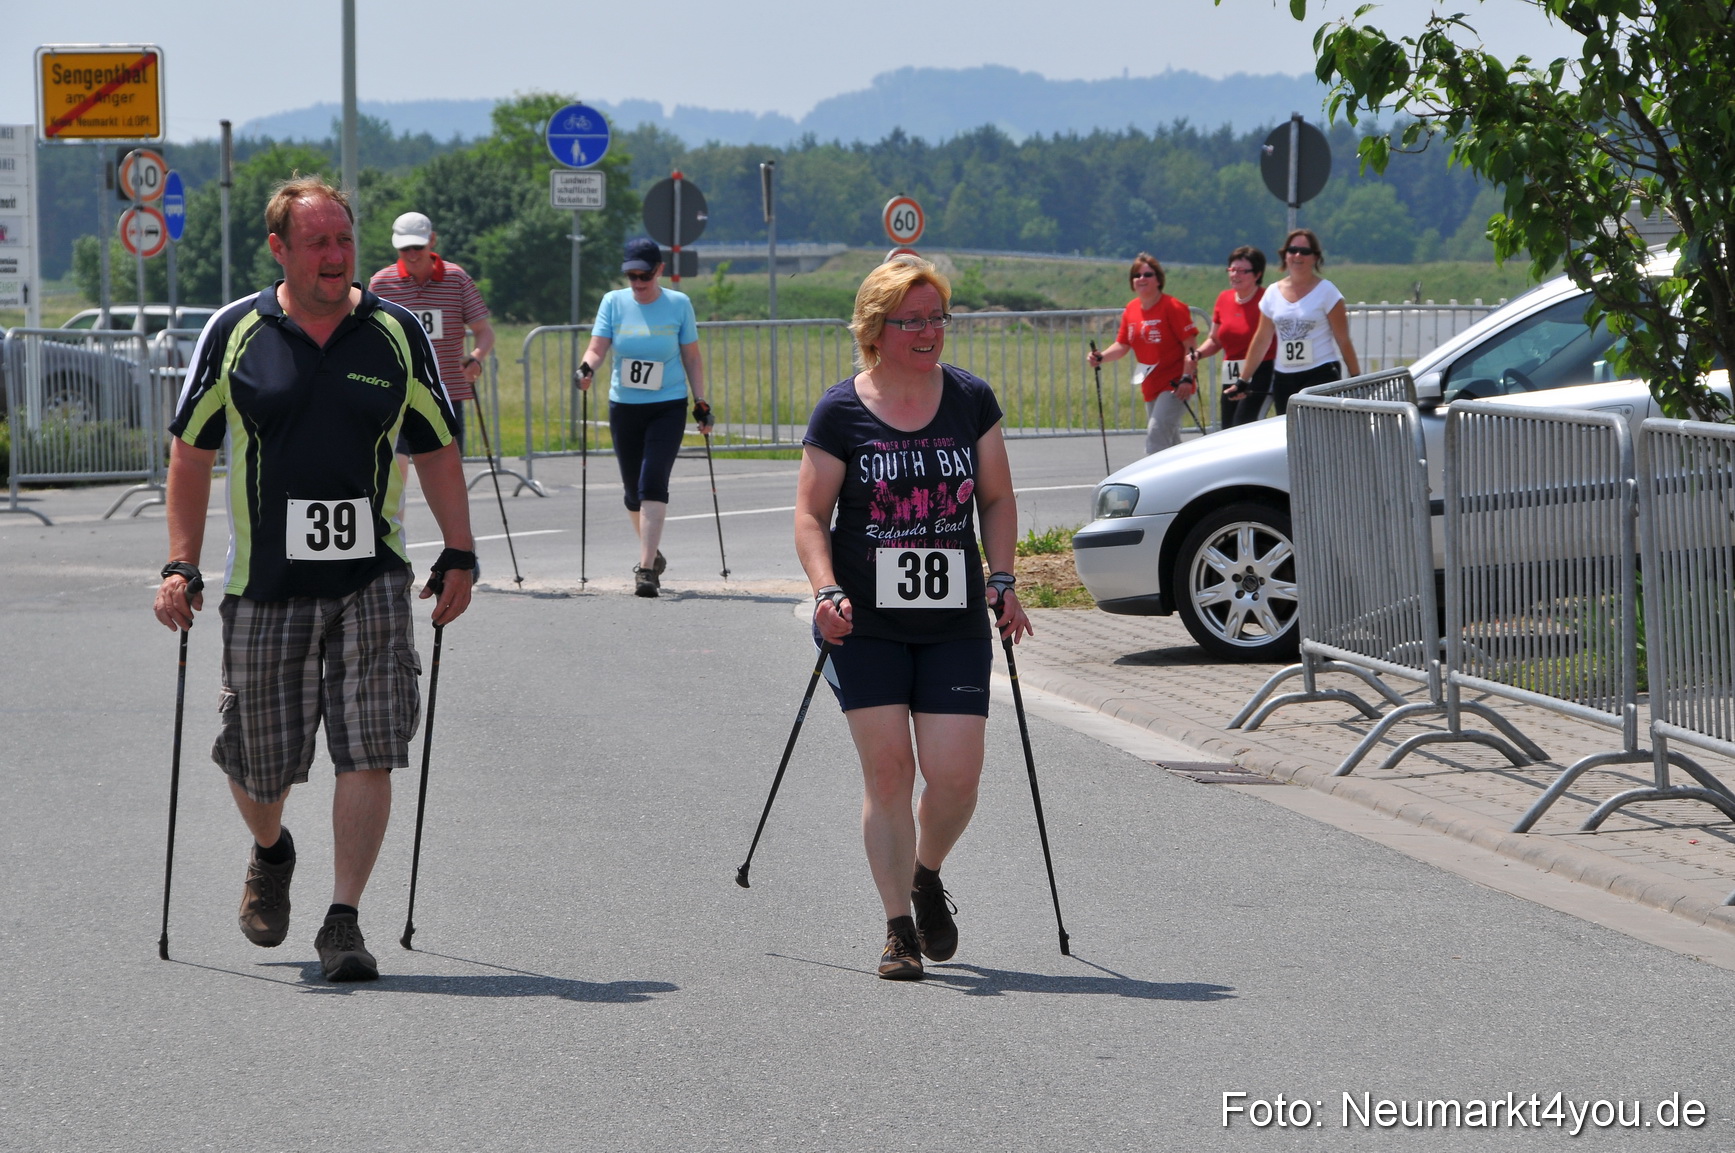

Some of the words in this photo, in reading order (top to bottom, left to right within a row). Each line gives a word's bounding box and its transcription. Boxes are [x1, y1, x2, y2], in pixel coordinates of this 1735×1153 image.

[52, 63, 148, 90] Sengenthal
[65, 93, 86, 104] am
[94, 91, 136, 107] Anger
[76, 116, 118, 127] Neumarkt
[557, 186, 598, 194] schaftlicher
[560, 176, 594, 184] Landwirt-
[557, 195, 583, 204] Verkehr
[586, 195, 599, 204] frei
[894, 210, 916, 231] 60
[413, 311, 434, 334] 8
[1285, 341, 1305, 361] 92
[346, 372, 391, 388] andro
[630, 360, 654, 385] 87
[1227, 362, 1241, 380] 14
[873, 441, 899, 452] TRADER
[902, 440, 910, 449] OF
[933, 437, 955, 448] GOODS
[860, 450, 925, 483] SOUTH
[936, 446, 973, 477] BAY
[305, 501, 357, 552] 39
[865, 522, 928, 540] Redondo
[934, 513, 968, 534] Beach
[897, 551, 949, 601] 38
